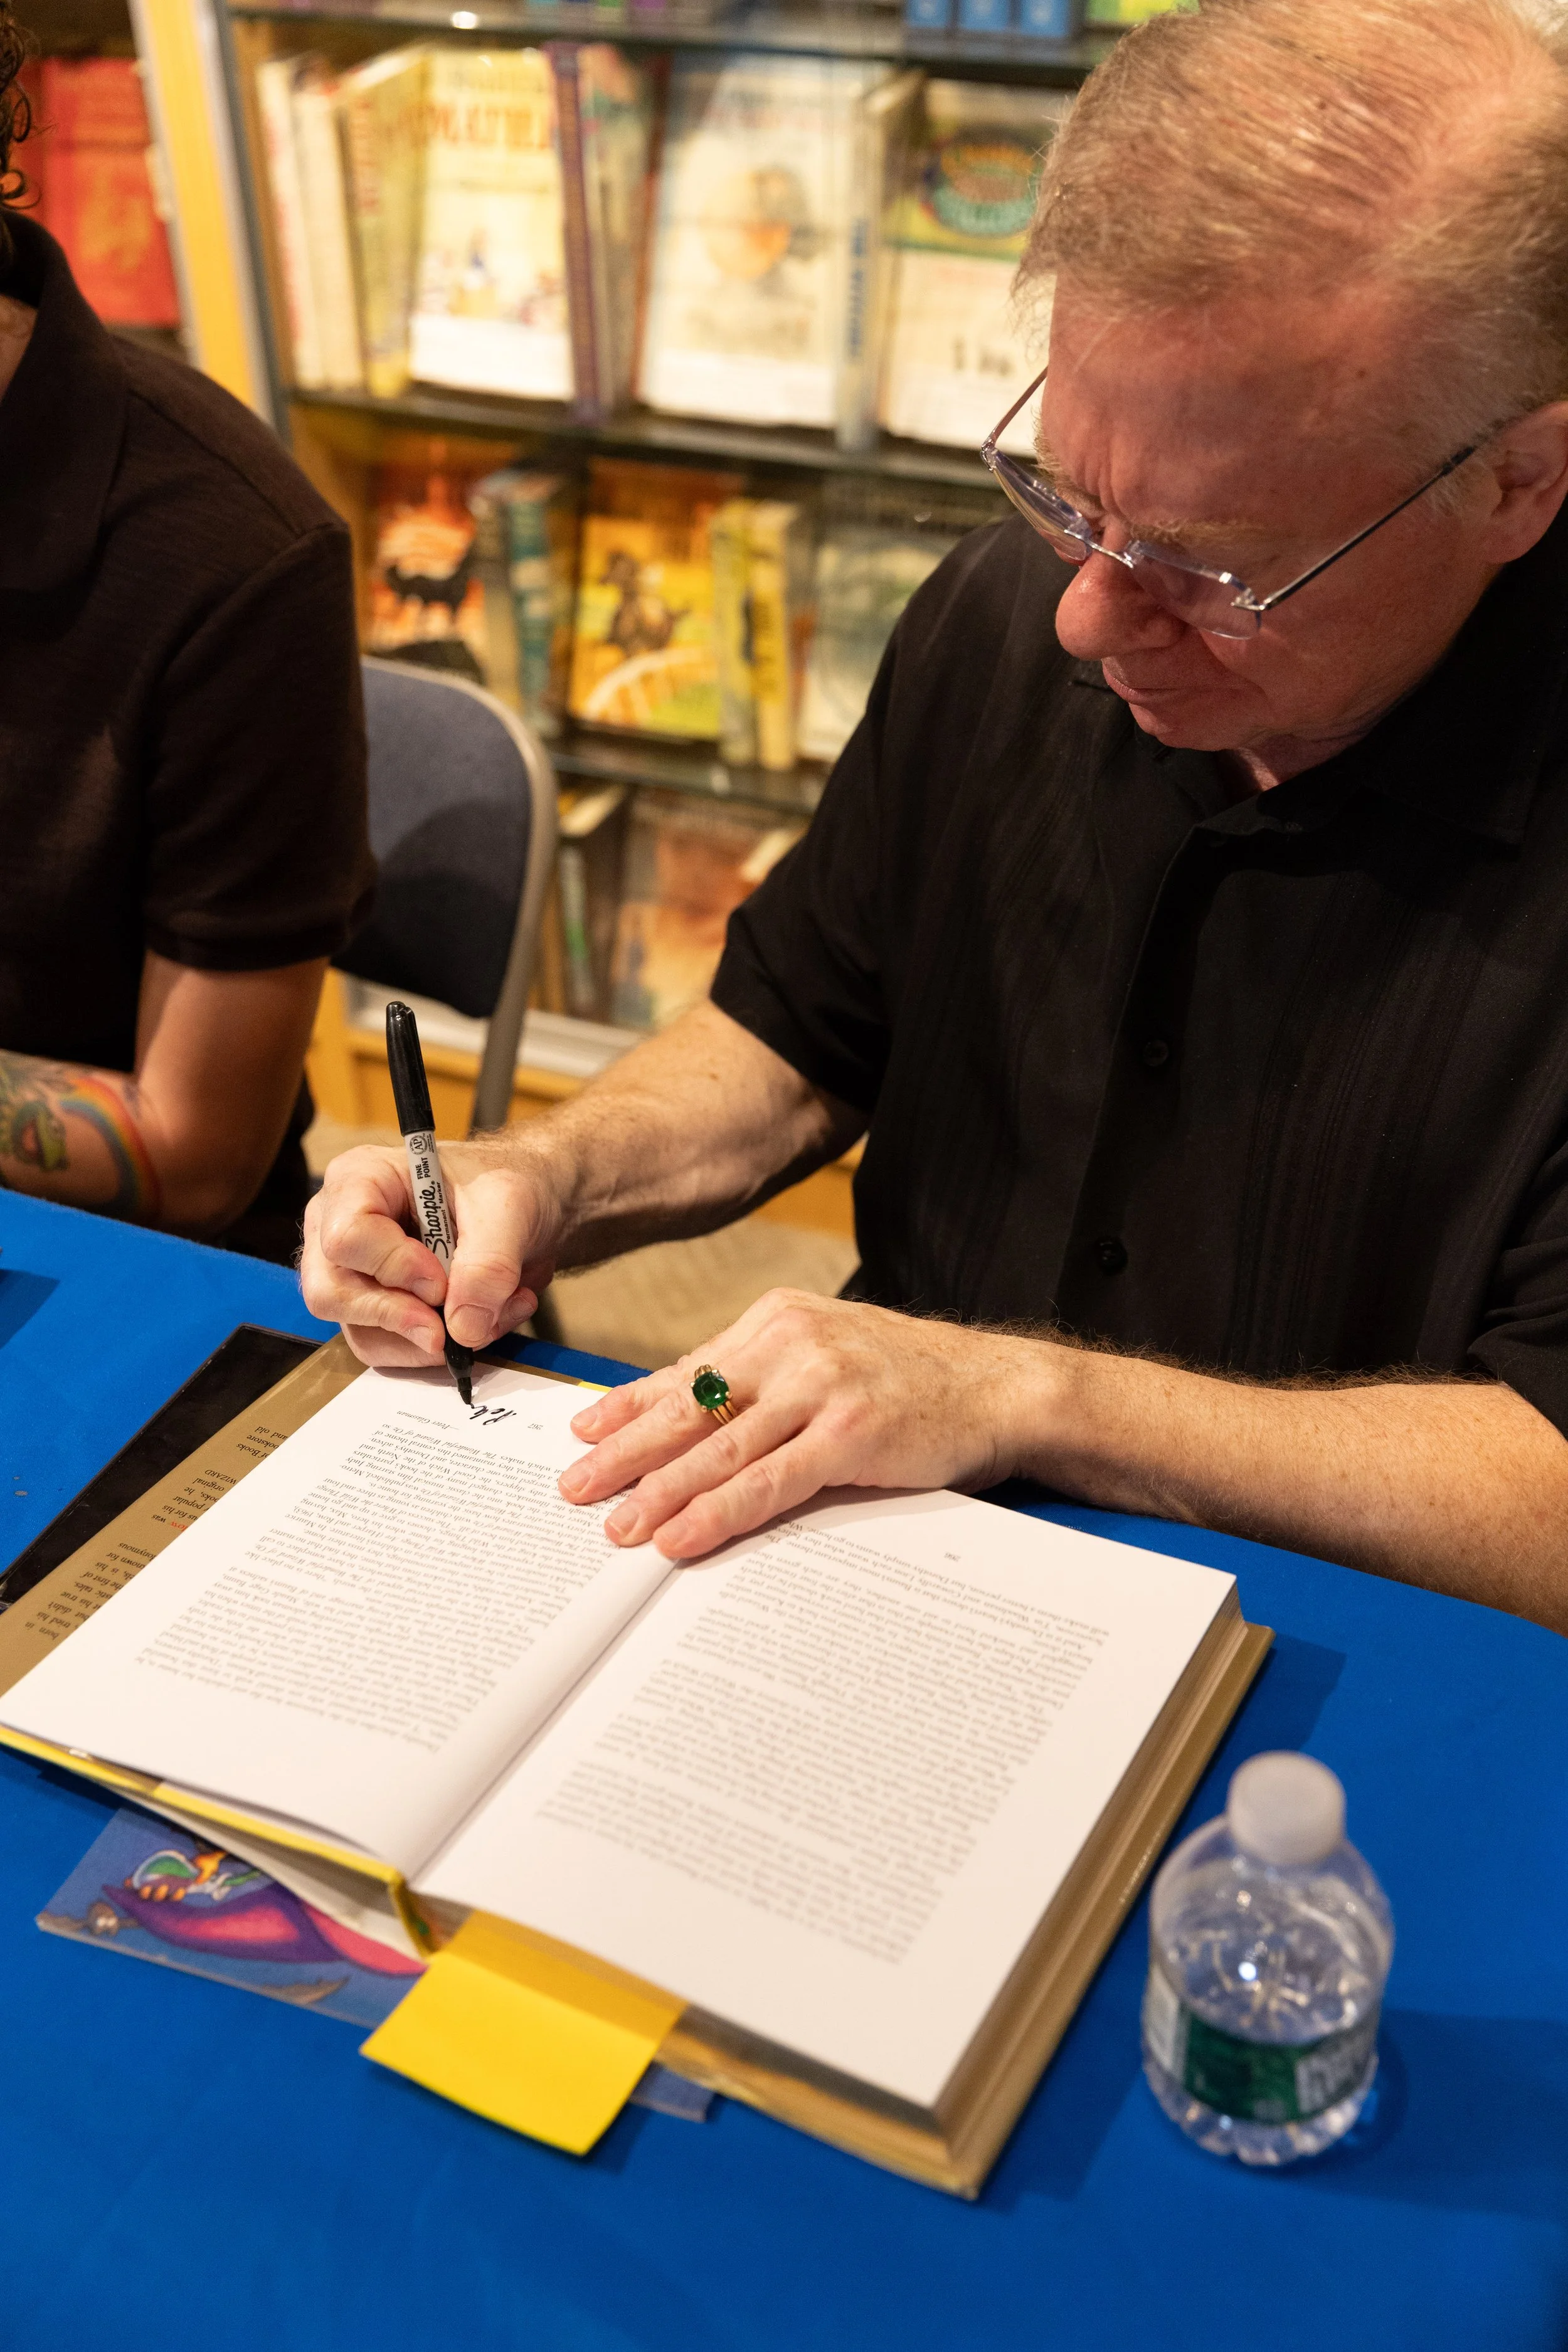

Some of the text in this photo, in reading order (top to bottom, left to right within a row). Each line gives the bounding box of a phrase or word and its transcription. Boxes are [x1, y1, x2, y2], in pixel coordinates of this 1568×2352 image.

[415, 1163, 423, 1180] FINE
[421, 1157, 431, 1178] POINT
[436, 1182, 452, 1244] Permanent Marker
[419, 1185, 449, 1259] Sharpie
[396, 1411, 430, 1424] Glassman
[401, 1428, 414, 1436] of
[246, 1434, 279, 1449] ookstore
[369, 1438, 394, 1448] adven-
[384, 1433, 408, 1444] theme
[413, 1433, 442, 1445] Wizard
[236, 1443, 261, 1457] Books
[408, 1440, 436, 1450] central
[441, 1441, 480, 1455] Wonderful
[352, 1450, 395, 1465] particulars
[378, 1448, 401, 1460] North
[450, 1452, 496, 1466] maintained
[482, 1451, 497, 1459] The
[448, 1459, 485, 1473] character,
[501, 1456, 525, 1465] makes
[339, 1465, 365, 1476] Metro-
[428, 1463, 450, 1475] Witch
[496, 1462, 514, 1472] they
[527, 1462, 551, 1471] which
[204, 1469, 237, 1485] WIZARD
[366, 1471, 406, 1486] published,
[420, 1470, 433, 1478] the
[452, 1470, 476, 1480] Good
[516, 1468, 546, 1480] dream),
[193, 1478, 225, 1492] original
[447, 1476, 468, 1486] many
[495, 1480, 525, 1493] slippers,
[517, 1478, 551, 1489] merged
[183, 1486, 220, 1502] ooks, he
[420, 1488, 432, 1496] Oz
[467, 1483, 503, 1495] changed
[528, 1488, 548, 1497] ruby
[172, 1495, 206, 1510] popular
[506, 1492, 550, 1508] filmmakers
[161, 1505, 175, 1515] his
[174, 1509, 188, 1518] for
[568, 1508, 600, 1521] Though
[151, 1514, 167, 1523] was
[586, 1530, 608, 1540] lmost
[106, 1552, 120, 1561] for
[95, 1561, 109, 1572] his
[110, 1567, 119, 1576] is
[93, 1575, 110, 1586] first
[74, 1581, 93, 1592] tales.
[60, 1591, 78, 1601] true
[79, 1598, 92, 1609] his
[36, 1612, 71, 1628] tried his
[24, 1621, 60, 1641] born in
